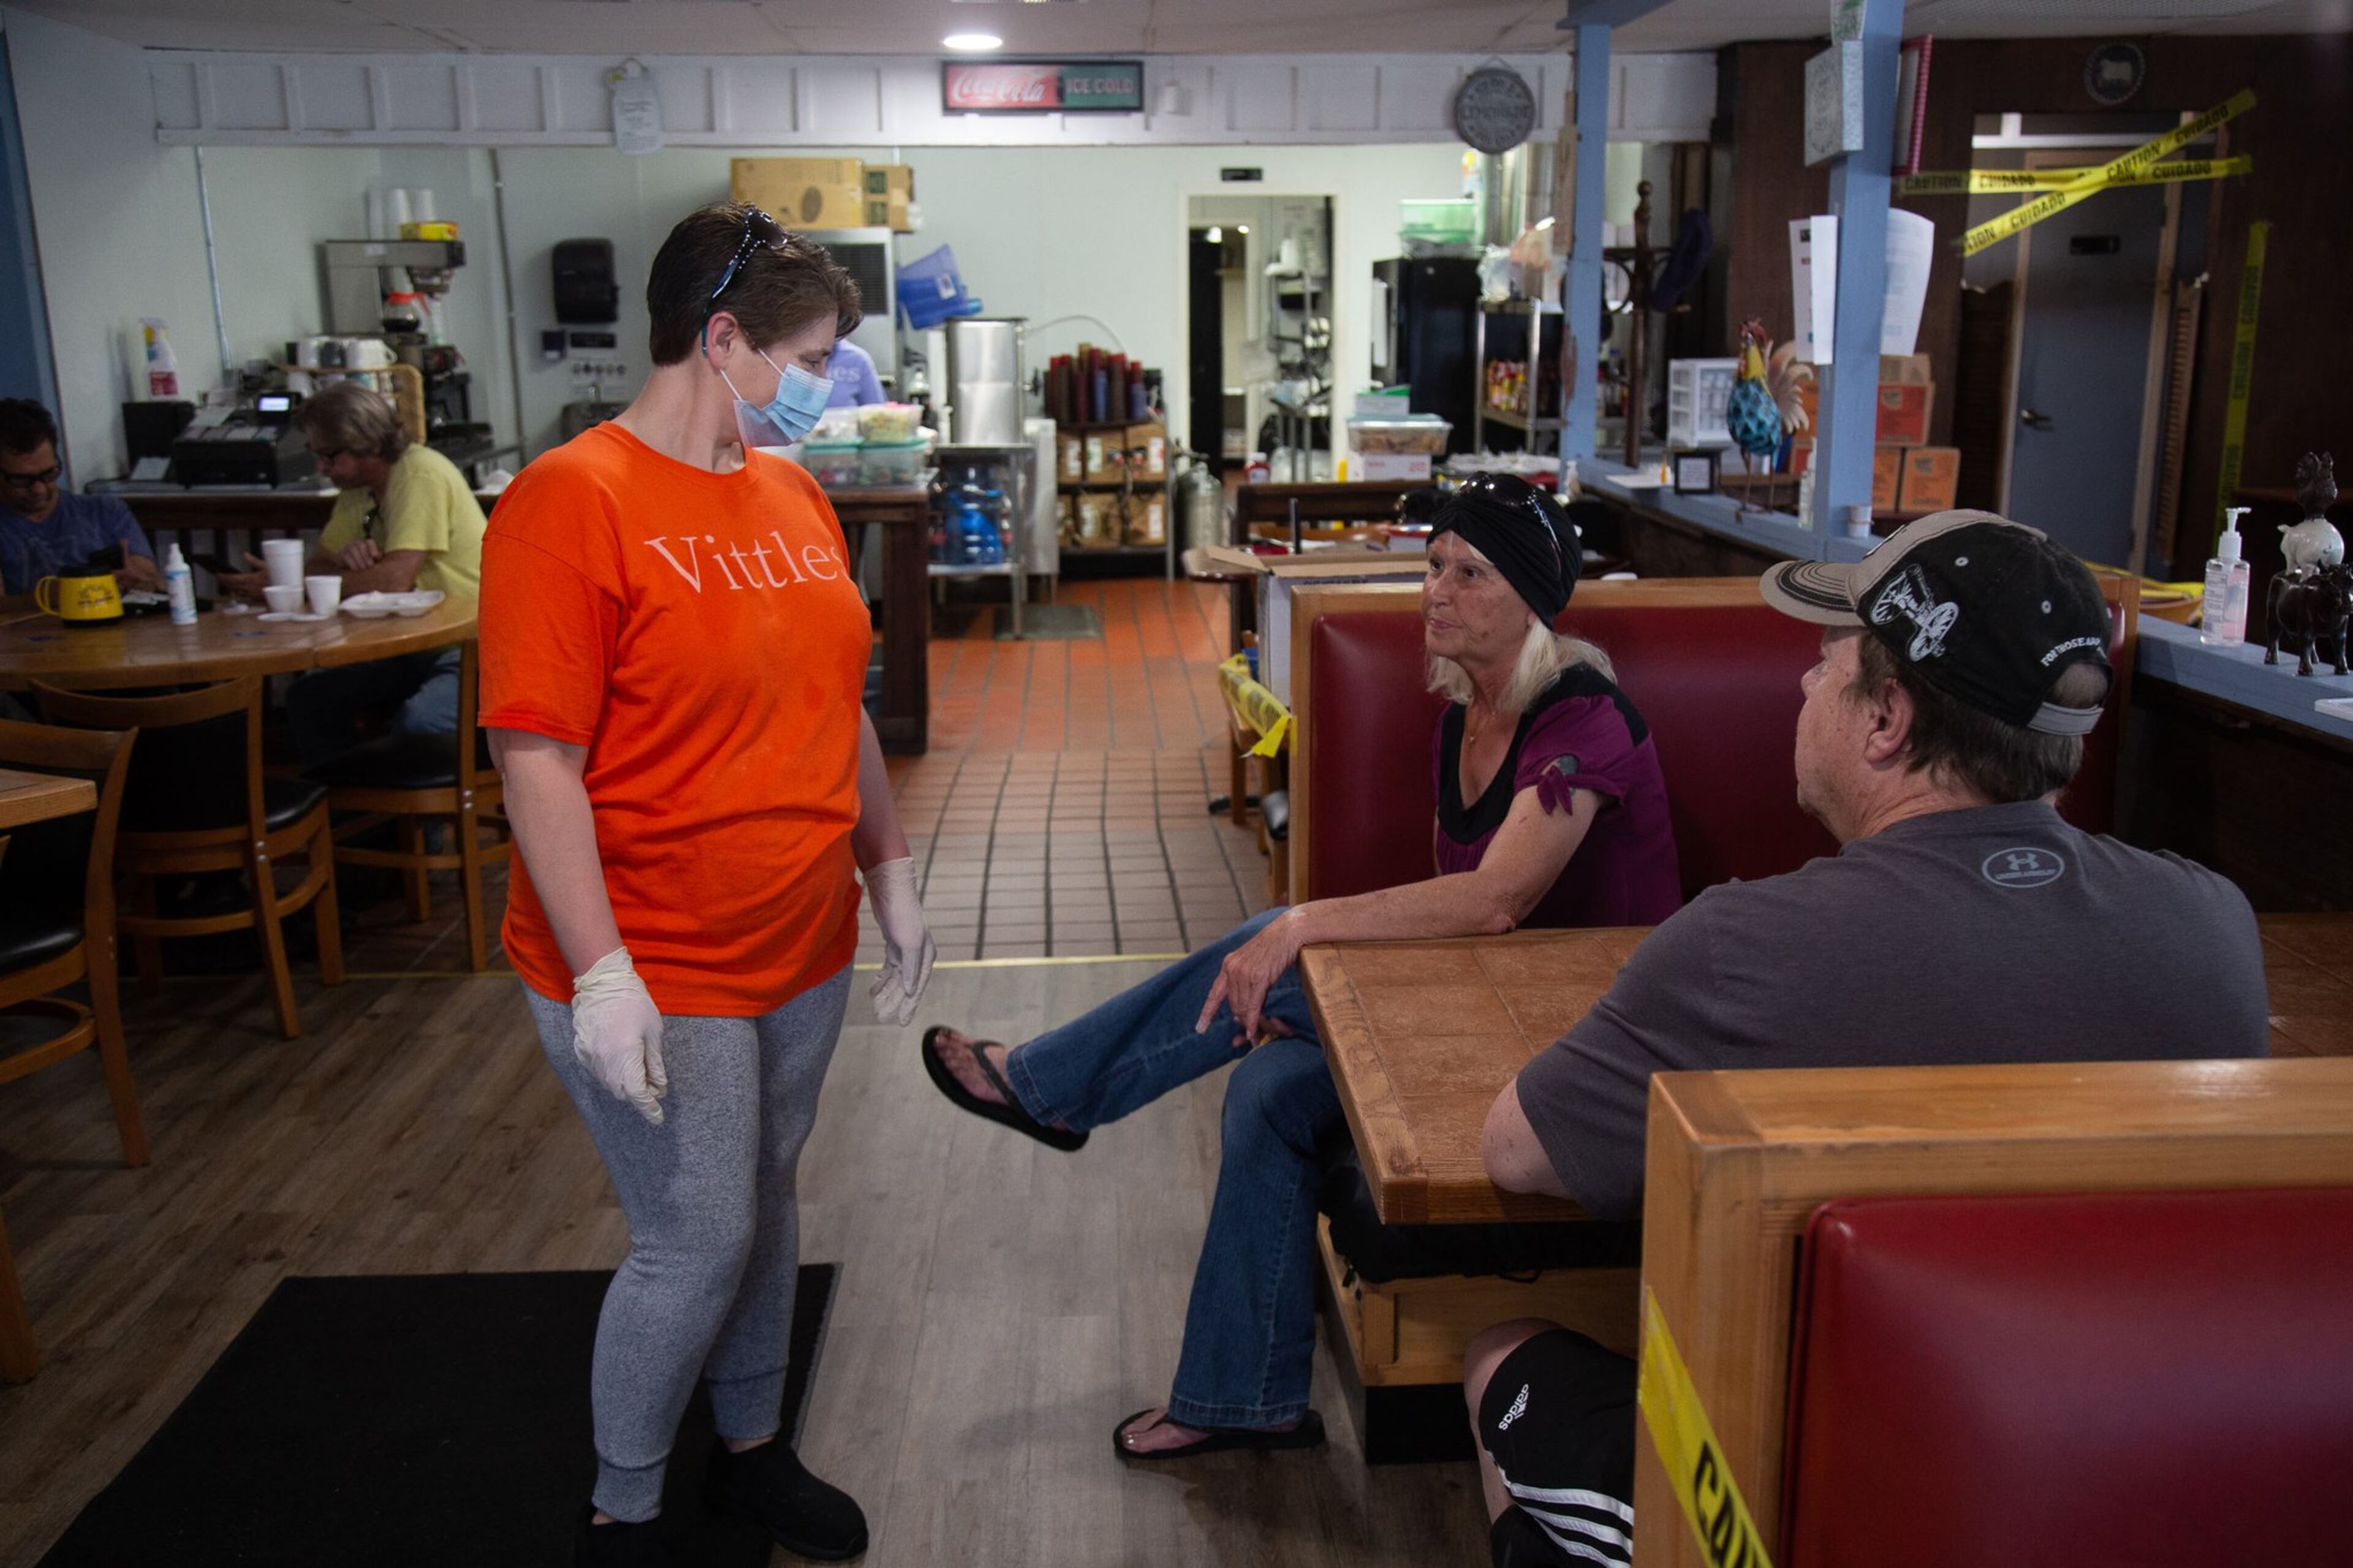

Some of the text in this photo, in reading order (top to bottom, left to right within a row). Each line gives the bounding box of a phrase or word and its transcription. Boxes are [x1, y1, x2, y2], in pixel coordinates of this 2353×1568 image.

[1067, 78, 1089, 93] ICE
[1094, 78, 1132, 93] COLD
[2152, 161, 2212, 178] CUIDADO
[2010, 191, 2067, 230] CUIDADO
[1498, 1384, 1529, 1431] adidas
